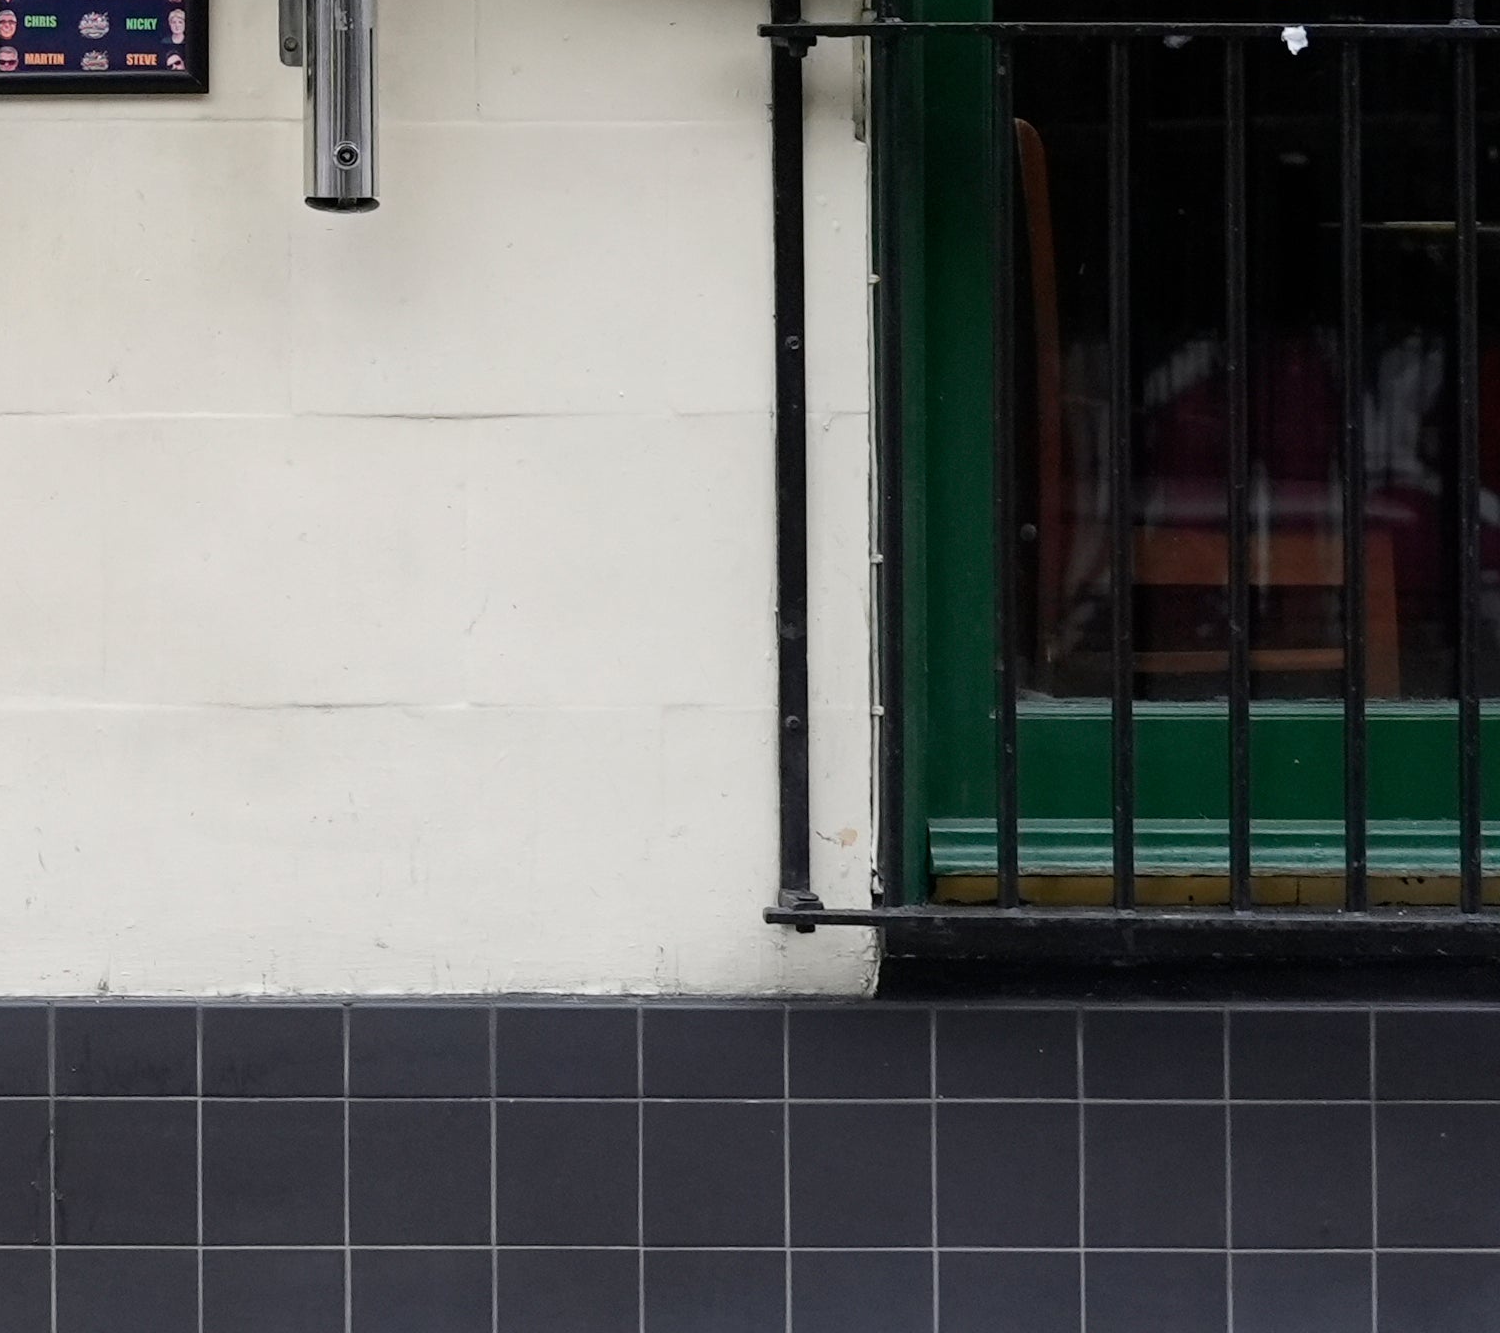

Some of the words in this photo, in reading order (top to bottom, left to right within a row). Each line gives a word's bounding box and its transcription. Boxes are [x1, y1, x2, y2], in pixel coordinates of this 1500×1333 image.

[24, 15, 57, 28] CHRIS
[125, 18, 158, 31] NICKY
[24, 53, 65, 65] MARTIN
[126, 53, 158, 66] STEVE
